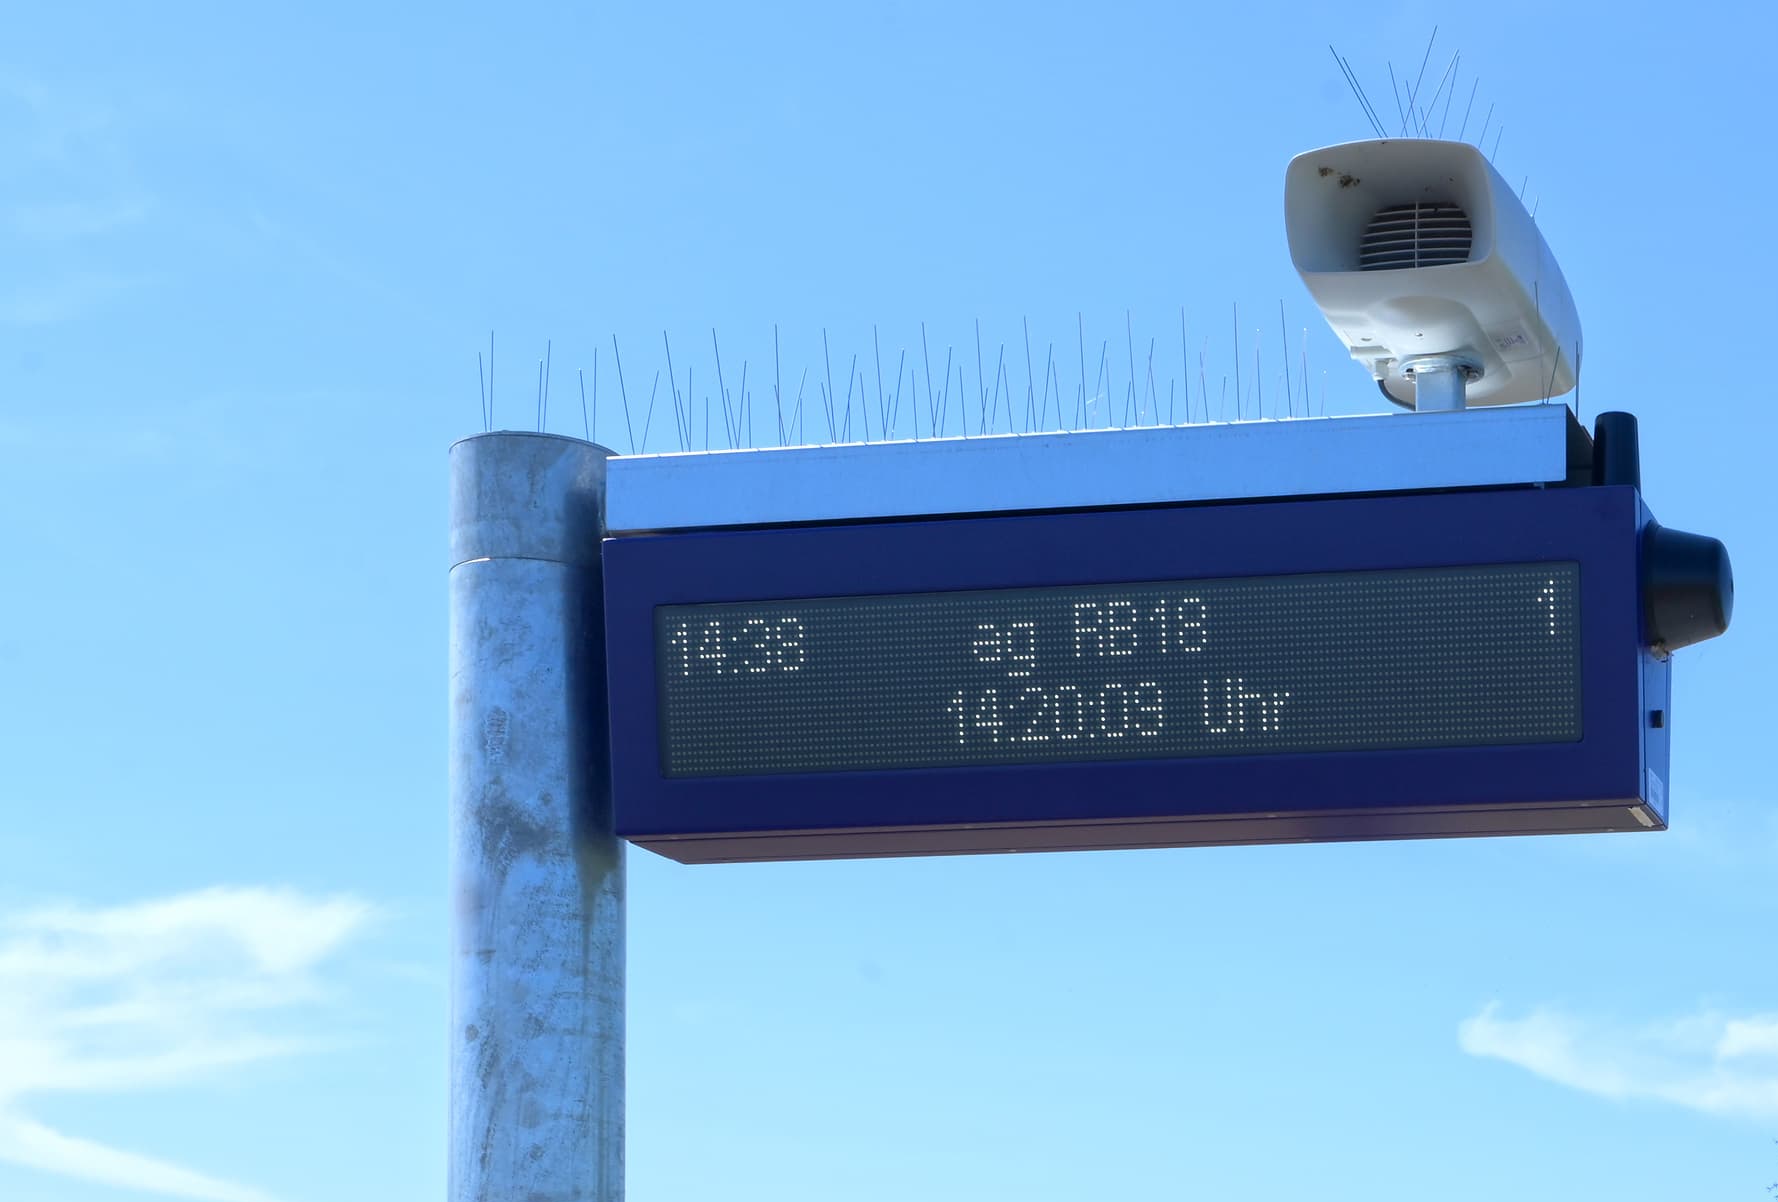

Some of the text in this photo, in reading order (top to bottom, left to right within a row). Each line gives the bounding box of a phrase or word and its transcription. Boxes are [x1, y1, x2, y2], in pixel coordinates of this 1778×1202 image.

[671, 579, 1555, 677] 14:38 ag RB18 1
[947, 678, 1290, 744] 14:20:09 Uhr
